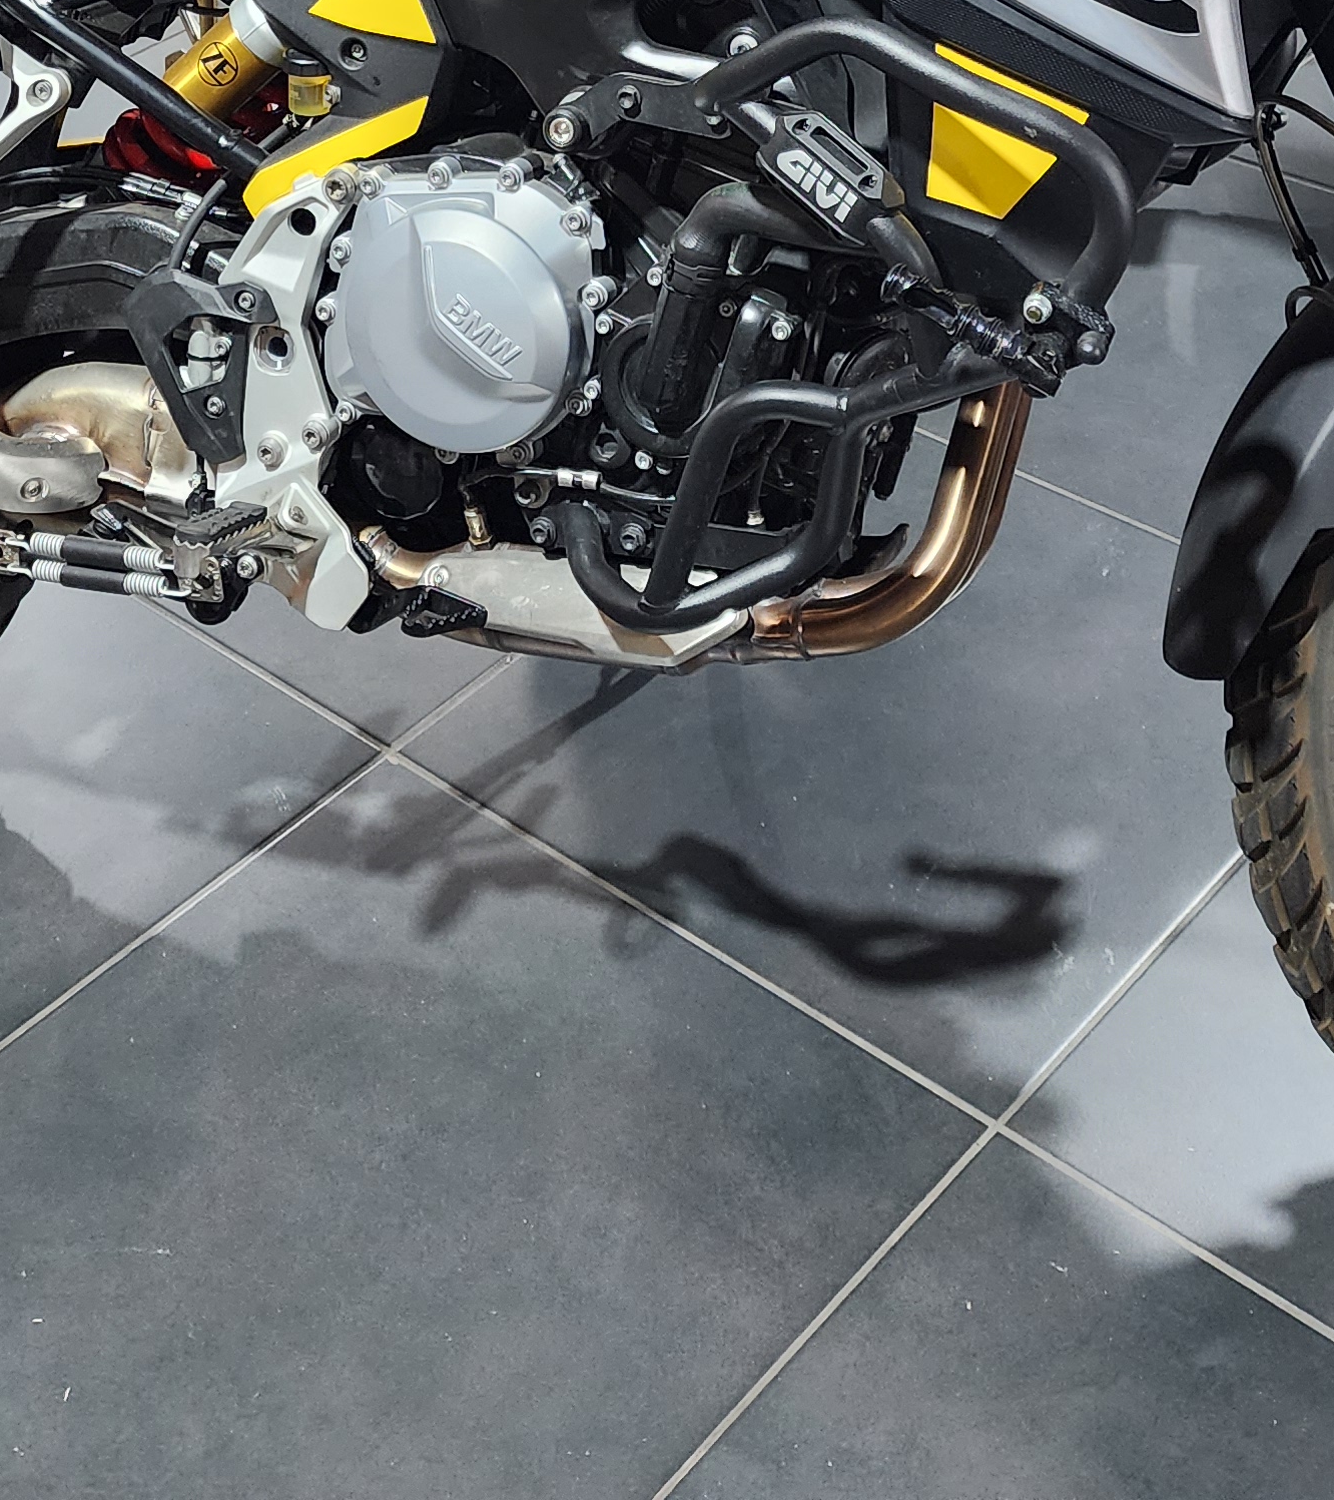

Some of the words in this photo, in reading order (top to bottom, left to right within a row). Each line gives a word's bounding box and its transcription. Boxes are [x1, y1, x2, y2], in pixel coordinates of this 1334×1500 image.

[201, 46, 237, 82] ZF
[776, 149, 857, 223] GIVI
[442, 293, 524, 369] BMW
